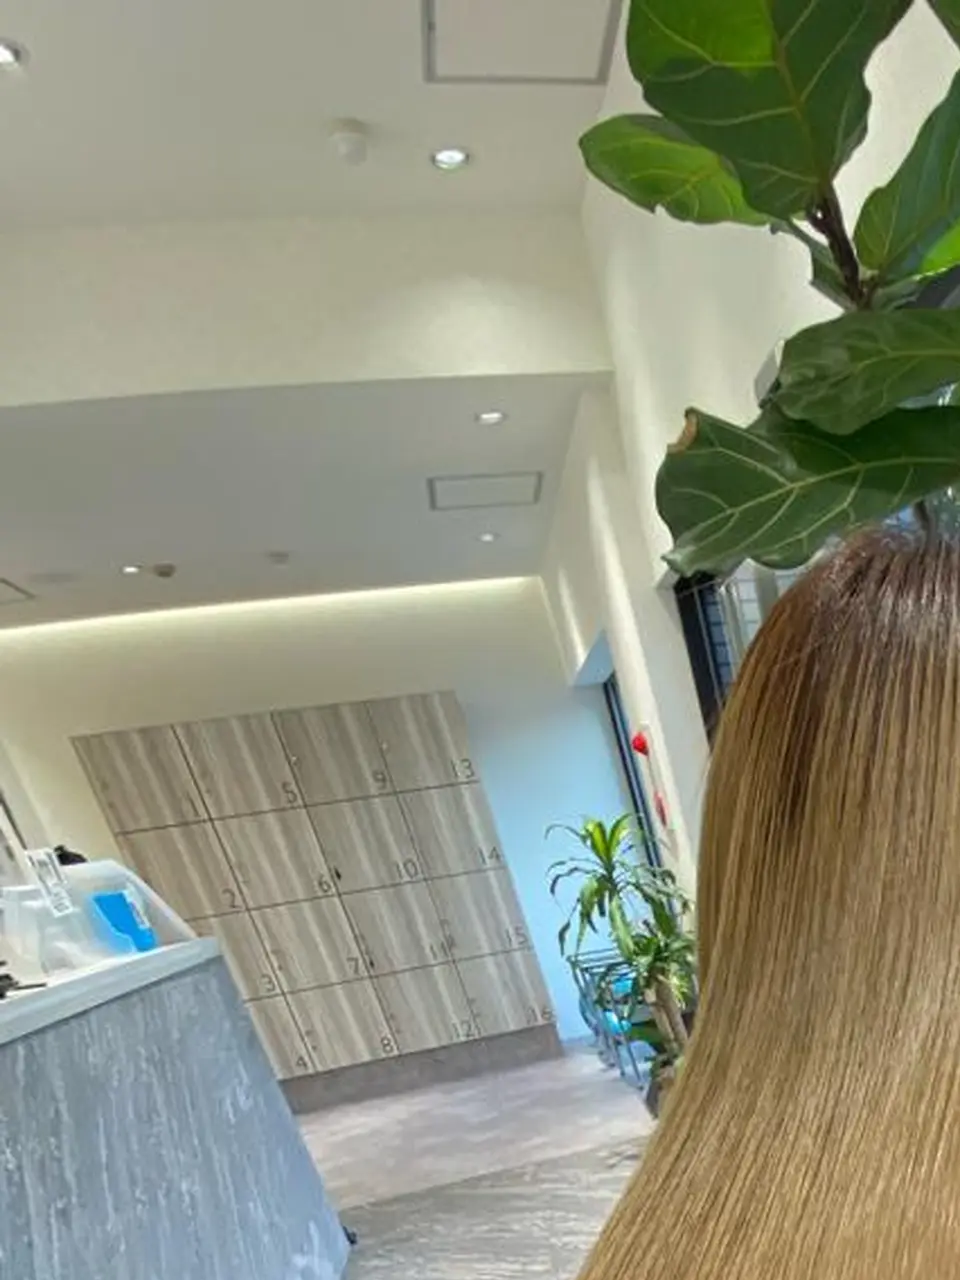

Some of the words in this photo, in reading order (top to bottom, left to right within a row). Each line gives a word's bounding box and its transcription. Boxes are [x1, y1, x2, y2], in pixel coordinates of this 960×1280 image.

[451, 758, 475, 779] 13
[373, 770, 387, 790] 9
[281, 781, 298, 804] 5
[478, 846, 501, 866] 14
[396, 858, 419, 880] 10
[318, 874, 332, 894] 6
[221, 888, 241, 909] 2
[506, 925, 528, 948] 15
[346, 956, 361, 975] 7
[260, 973, 276, 993] 3
[453, 1019, 476, 1040] 12
[380, 1035, 394, 1054] 8
[296, 1056, 308, 1071] 4
